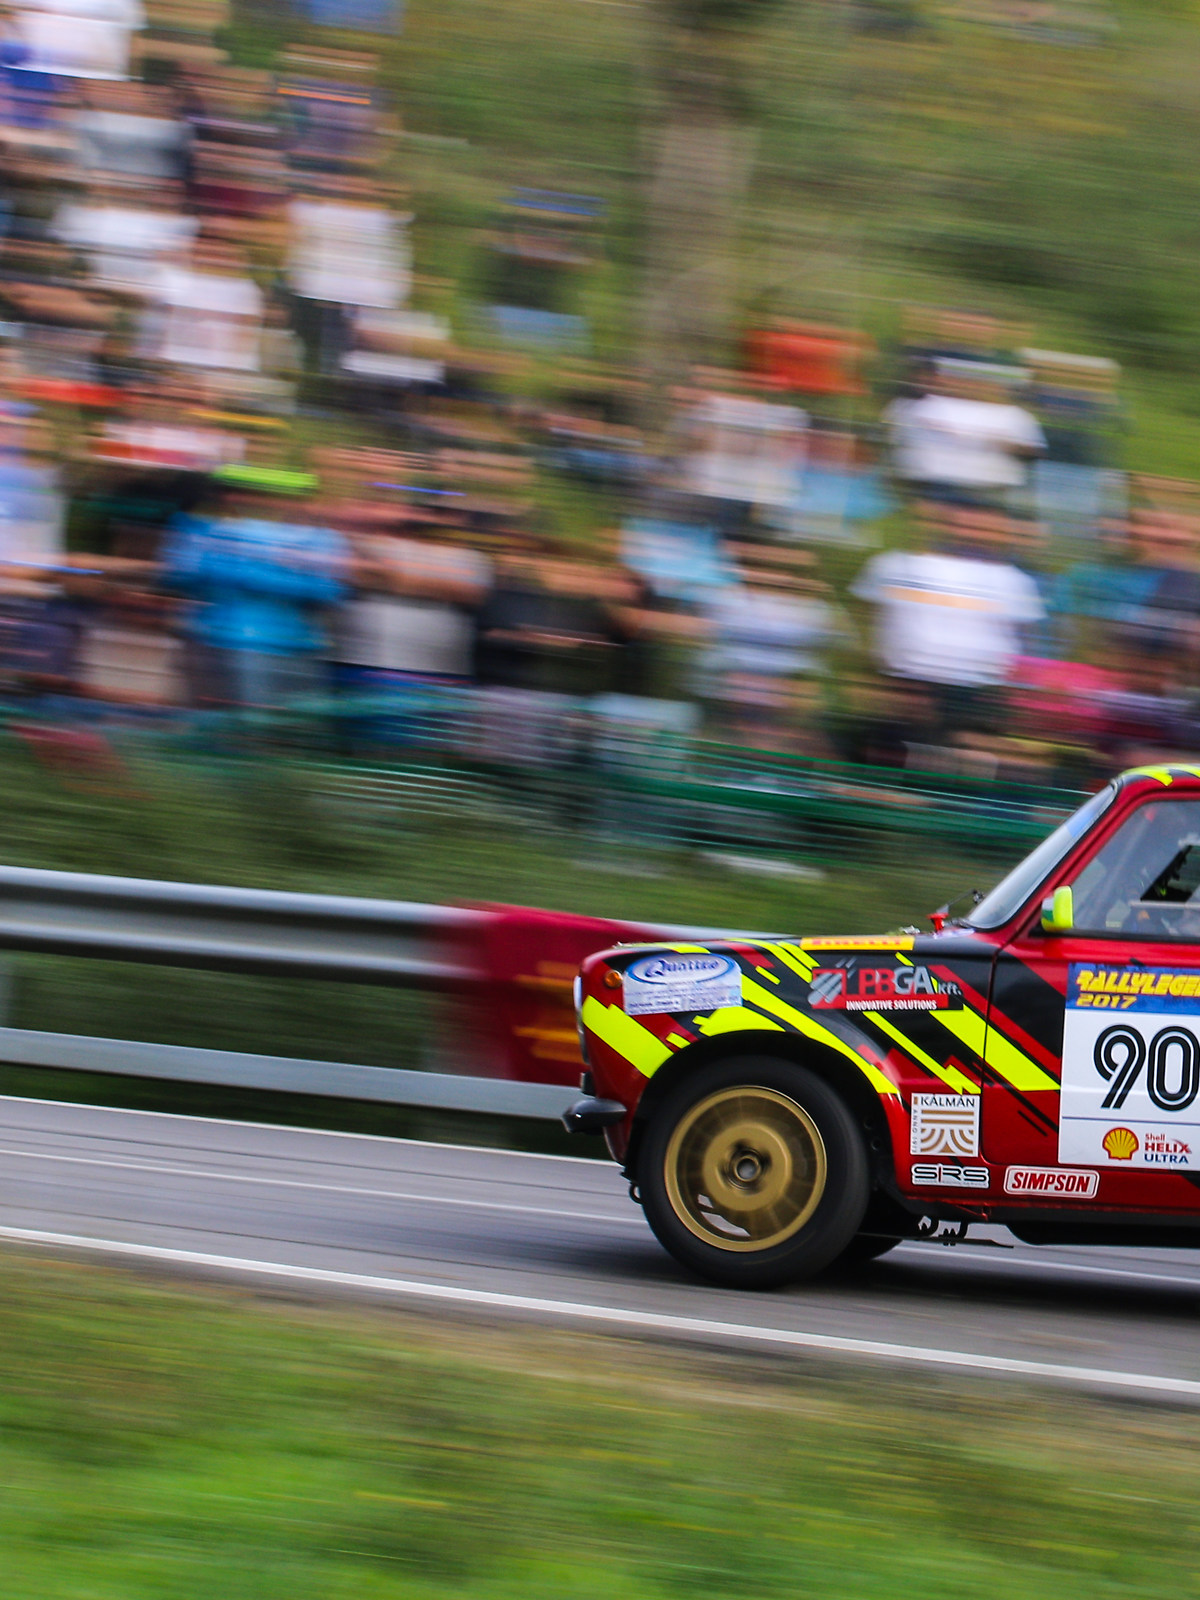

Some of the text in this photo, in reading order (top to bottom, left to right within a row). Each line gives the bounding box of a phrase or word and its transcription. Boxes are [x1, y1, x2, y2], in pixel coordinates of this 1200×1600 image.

[846, 1000, 937, 1011] INNOVATIVE SOLUTIONS
[1076, 993, 1138, 1009] 2017
[1093, 1024, 1200, 1112] 90
[1145, 1133, 1166, 1142] Shell
[1144, 1140, 1193, 1154] HELIX
[1144, 1154, 1190, 1164] ULTRA
[1012, 1172, 1091, 1192] SIMPSON
